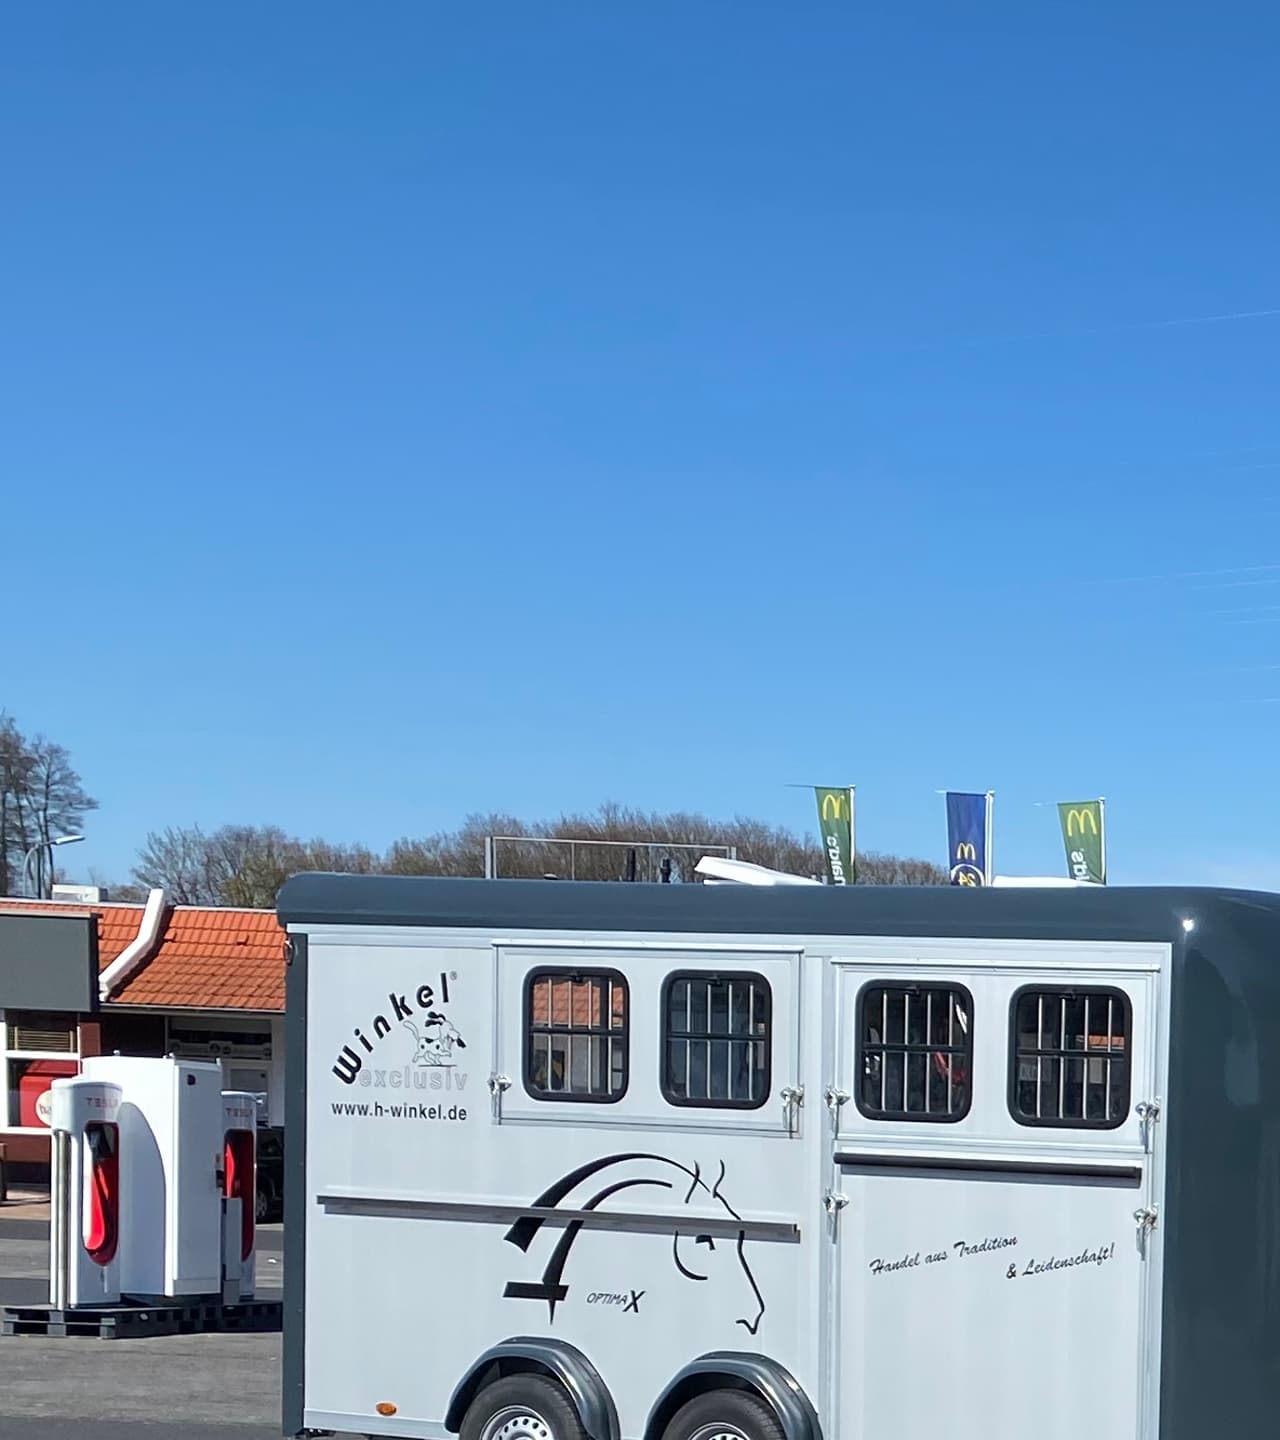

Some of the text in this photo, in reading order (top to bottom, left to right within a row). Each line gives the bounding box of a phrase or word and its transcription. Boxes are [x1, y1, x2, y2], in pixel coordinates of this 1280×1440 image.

[331, 1101, 467, 1121] www.h-winkel.de
[869, 1234, 1018, 1276] Handel aus Tradition
[1006, 1242, 1116, 1279] & Leidenschaft!
